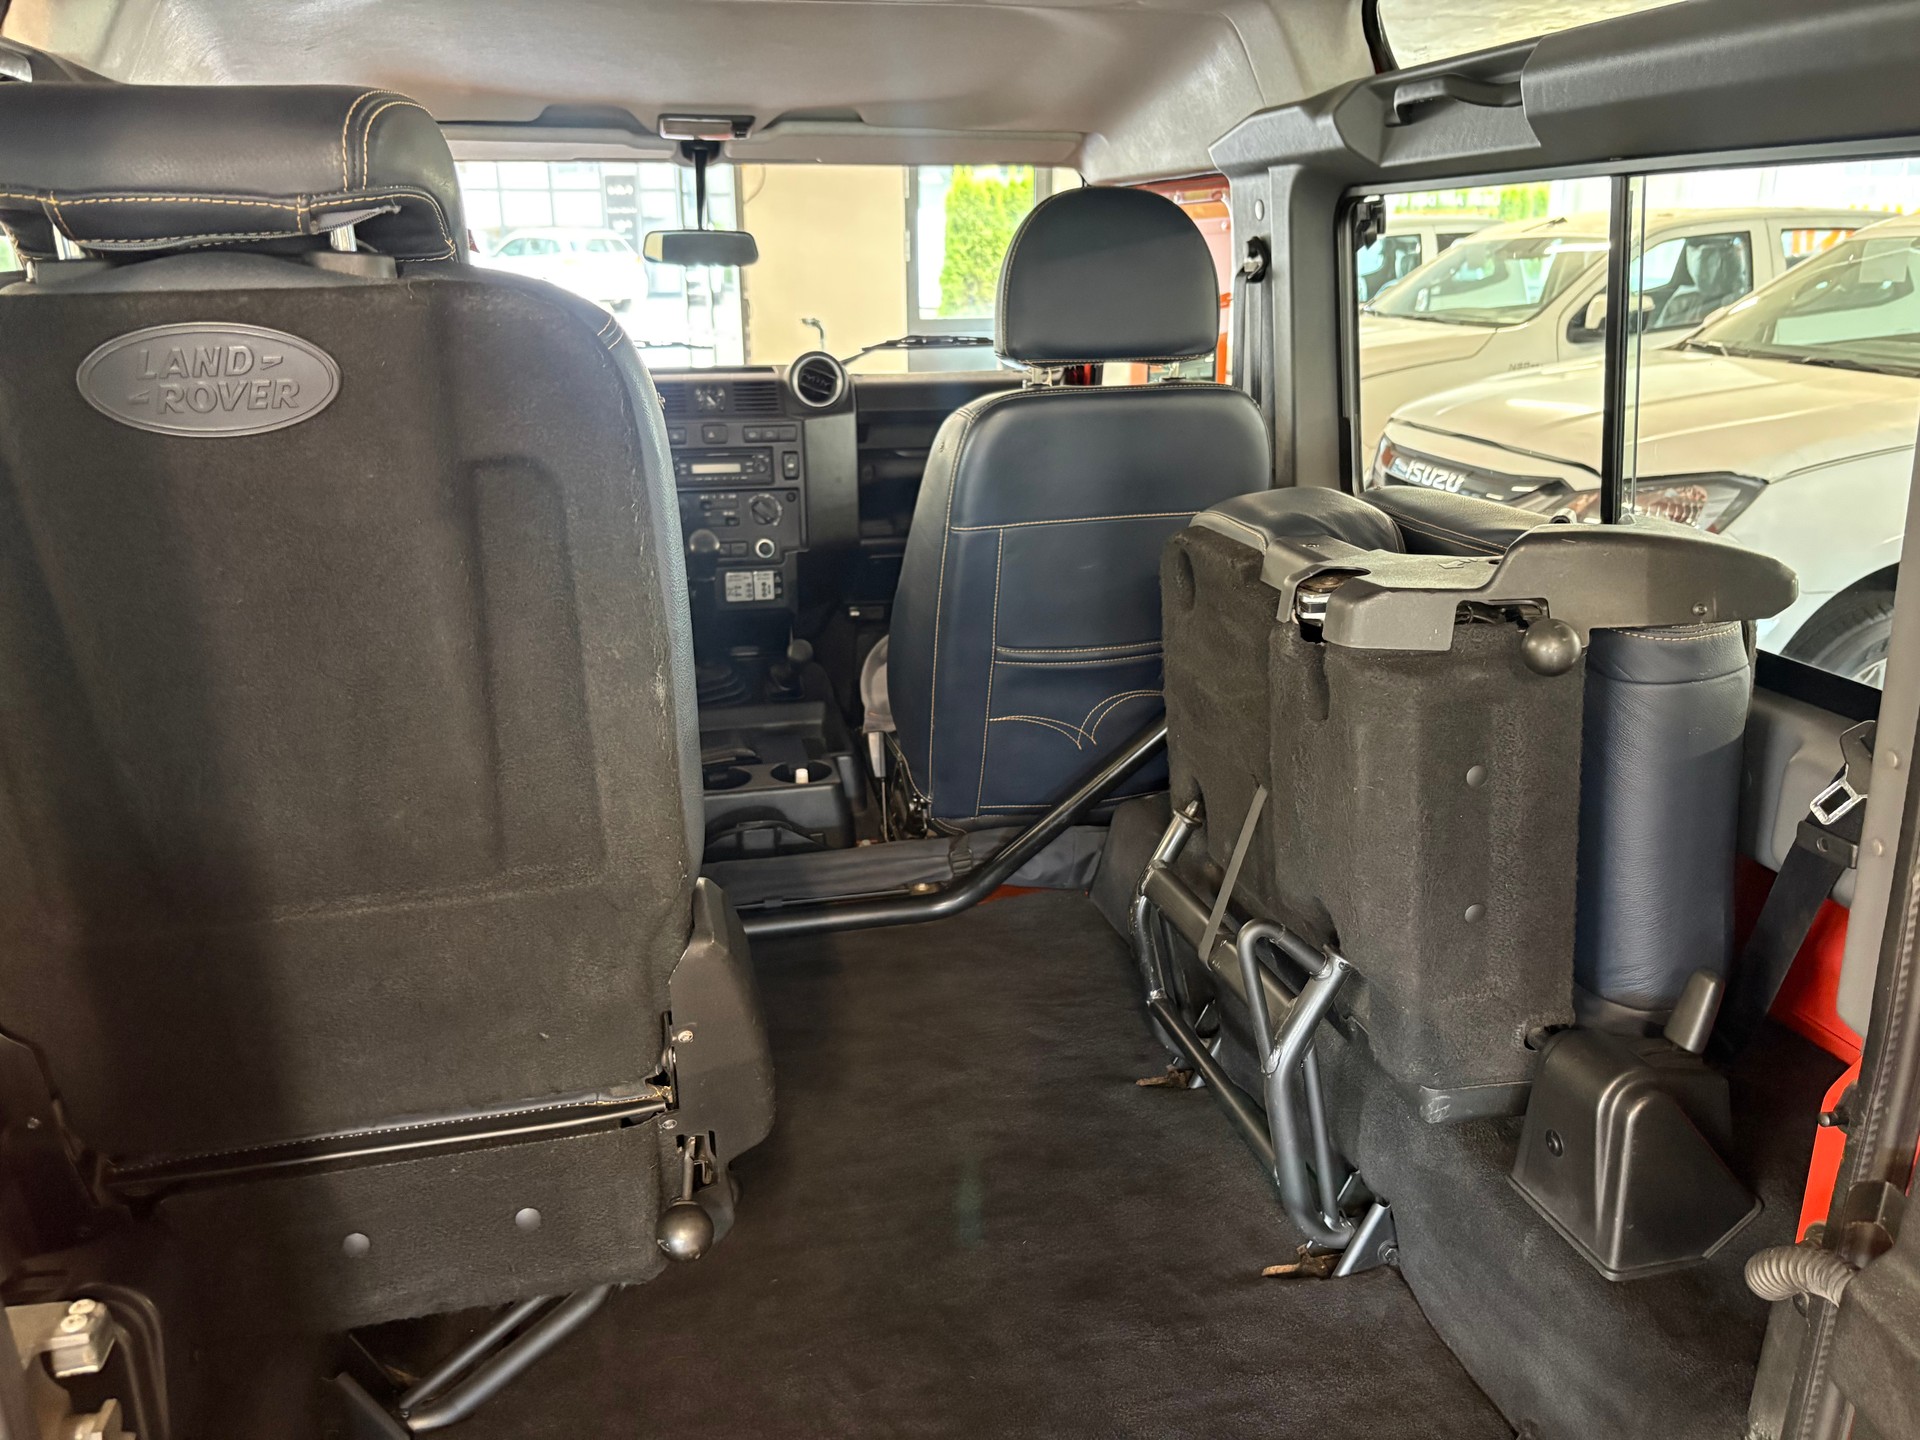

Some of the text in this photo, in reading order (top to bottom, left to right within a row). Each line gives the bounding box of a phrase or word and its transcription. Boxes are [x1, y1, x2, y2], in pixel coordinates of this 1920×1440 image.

[136, 345, 254, 380] LAND
[158, 378, 300, 414] ROVER
[1404, 459, 1466, 493] ISUZU
